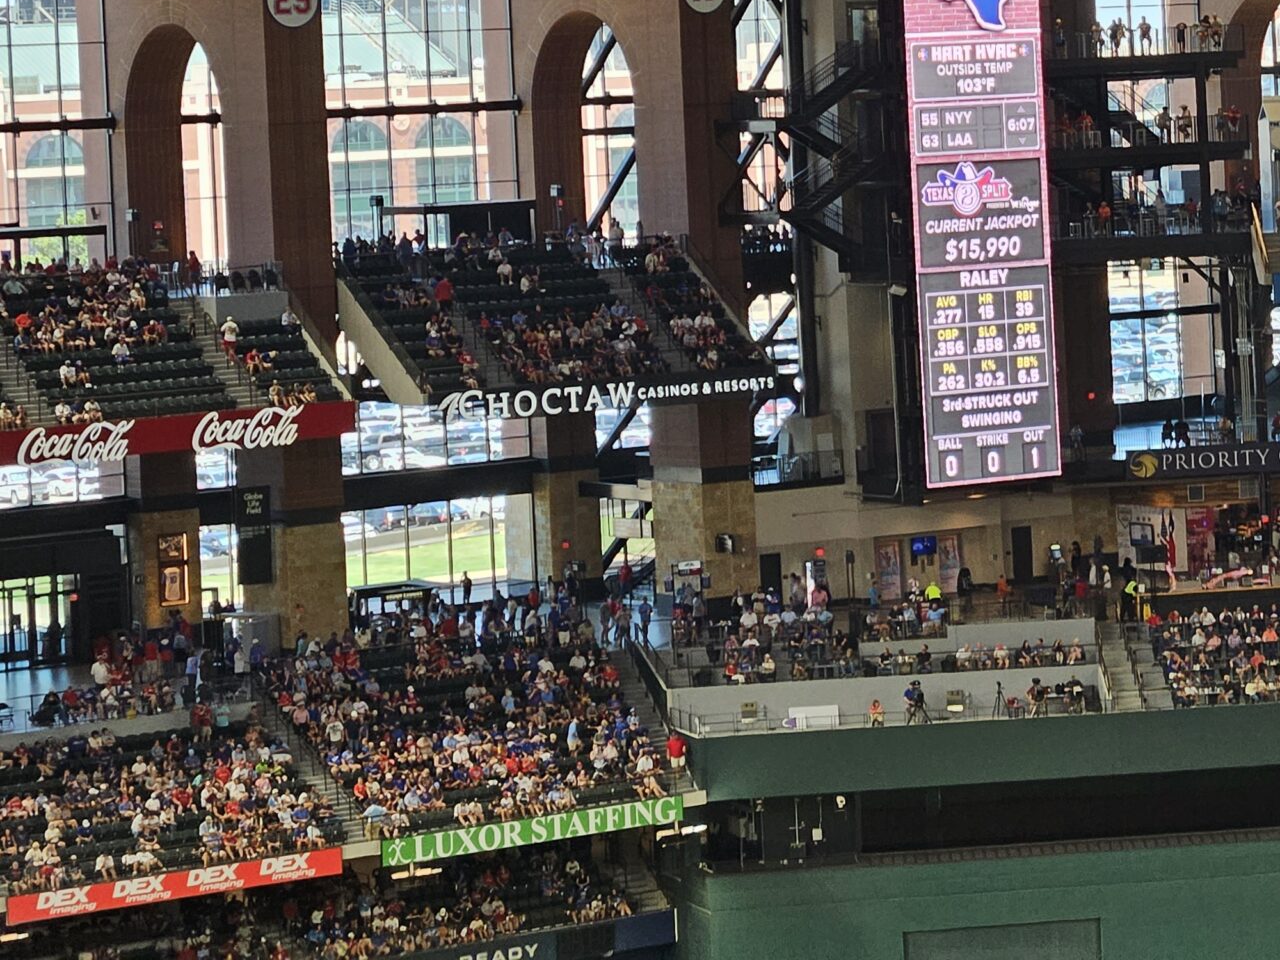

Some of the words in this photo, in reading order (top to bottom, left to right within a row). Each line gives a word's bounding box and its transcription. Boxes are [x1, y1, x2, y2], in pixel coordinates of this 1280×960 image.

[931, 44, 972, 63] HART
[975, 43, 1018, 60] HVAC
[936, 63, 982, 76] OUTSIDE
[983, 61, 1013, 74] TEMP
[956, 77, 995, 93] 103°F
[921, 112, 938, 126] 55
[945, 110, 972, 125] NYY
[1007, 117, 1035, 132] 6:07
[922, 134, 939, 148] 63
[947, 132, 973, 147] LAA
[926, 187, 954, 201] TEXAS
[981, 184, 1007, 198] SPLIT
[925, 217, 983, 234] CURRENT
[983, 213, 1040, 230] JACKPOT
[945, 235, 1021, 262] $15,990
[960, 268, 1009, 288] RALEY
[936, 295, 957, 308] AVG
[978, 292, 993, 305] HR
[1015, 290, 1033, 302] RBI
[933, 308, 962, 324] .277
[978, 304, 994, 320] 15
[1015, 301, 1034, 317] 39
[937, 328, 959, 341] OBP
[978, 325, 997, 337] SLG
[1016, 322, 1037, 335] OPS
[943, 363, 957, 375] PA
[981, 359, 996, 372] K%
[938, 375, 965, 391] 262
[974, 372, 1005, 388] 30.2
[459, 381, 635, 420] CHOCTAW
[637, 382, 698, 400] CASINOS
[701, 381, 711, 396] &
[714, 376, 774, 394] RESORTS
[1013, 391, 1039, 406] OUT
[962, 410, 1022, 428] SWINGING
[192, 405, 302, 452] Coca-Cola
[1023, 430, 1045, 442] OUT
[17, 419, 135, 466] Coca-Cola
[938, 439, 962, 451] BALL
[976, 433, 1009, 447] STRIKE
[987, 451, 999, 473] 0
[1031, 446, 1039, 469] 1
[1162, 447, 1269, 471] PRIORITY
[945, 455, 957, 477] 0
[414, 821, 523, 861] LUXOR
[531, 796, 678, 844] STAFFING
[259, 852, 311, 876] DEX
[187, 863, 240, 887] DEX
[272, 866, 315, 881] imaging
[112, 874, 167, 899] DEX
[199, 878, 243, 892] imaging
[36, 886, 91, 910] DEX
[125, 890, 171, 904] imaging
[50, 901, 97, 915] imaging
